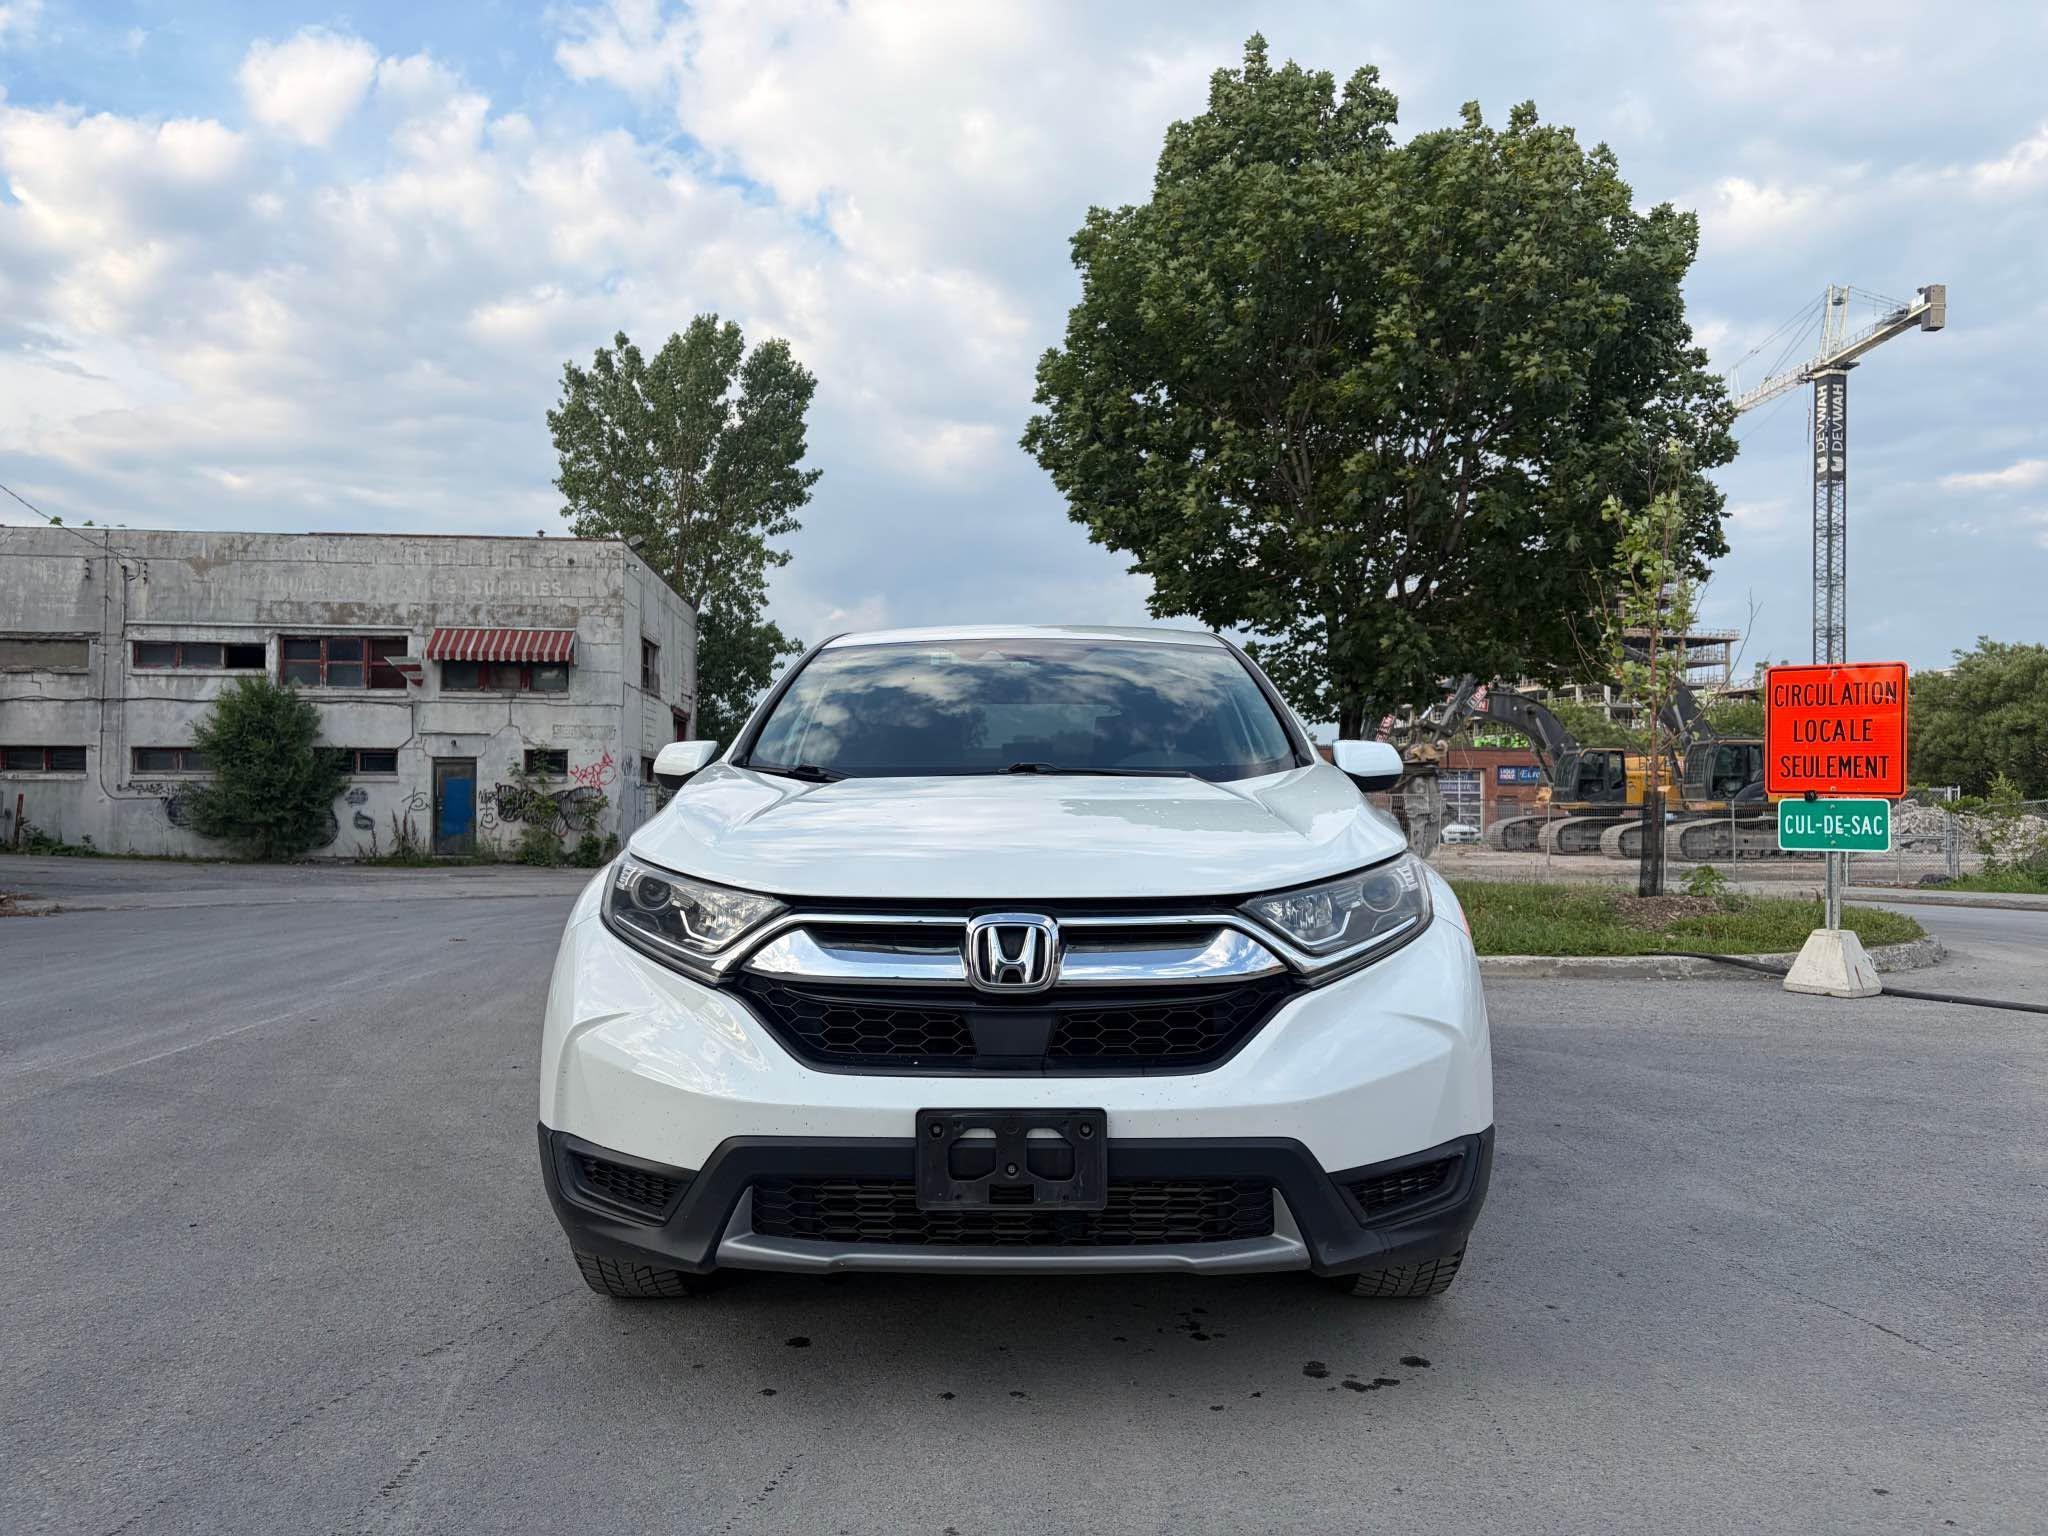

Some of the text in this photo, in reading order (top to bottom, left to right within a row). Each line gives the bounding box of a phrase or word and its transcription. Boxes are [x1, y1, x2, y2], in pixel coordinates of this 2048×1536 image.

[1832, 384, 1843, 451] DEVWAH
[1774, 680, 1898, 708] CIRCULATION
[1793, 718, 1874, 743] LOCALE
[1780, 754, 1890, 780] SEULEMENT
[1784, 814, 1884, 836] CUL-DE-SAC
